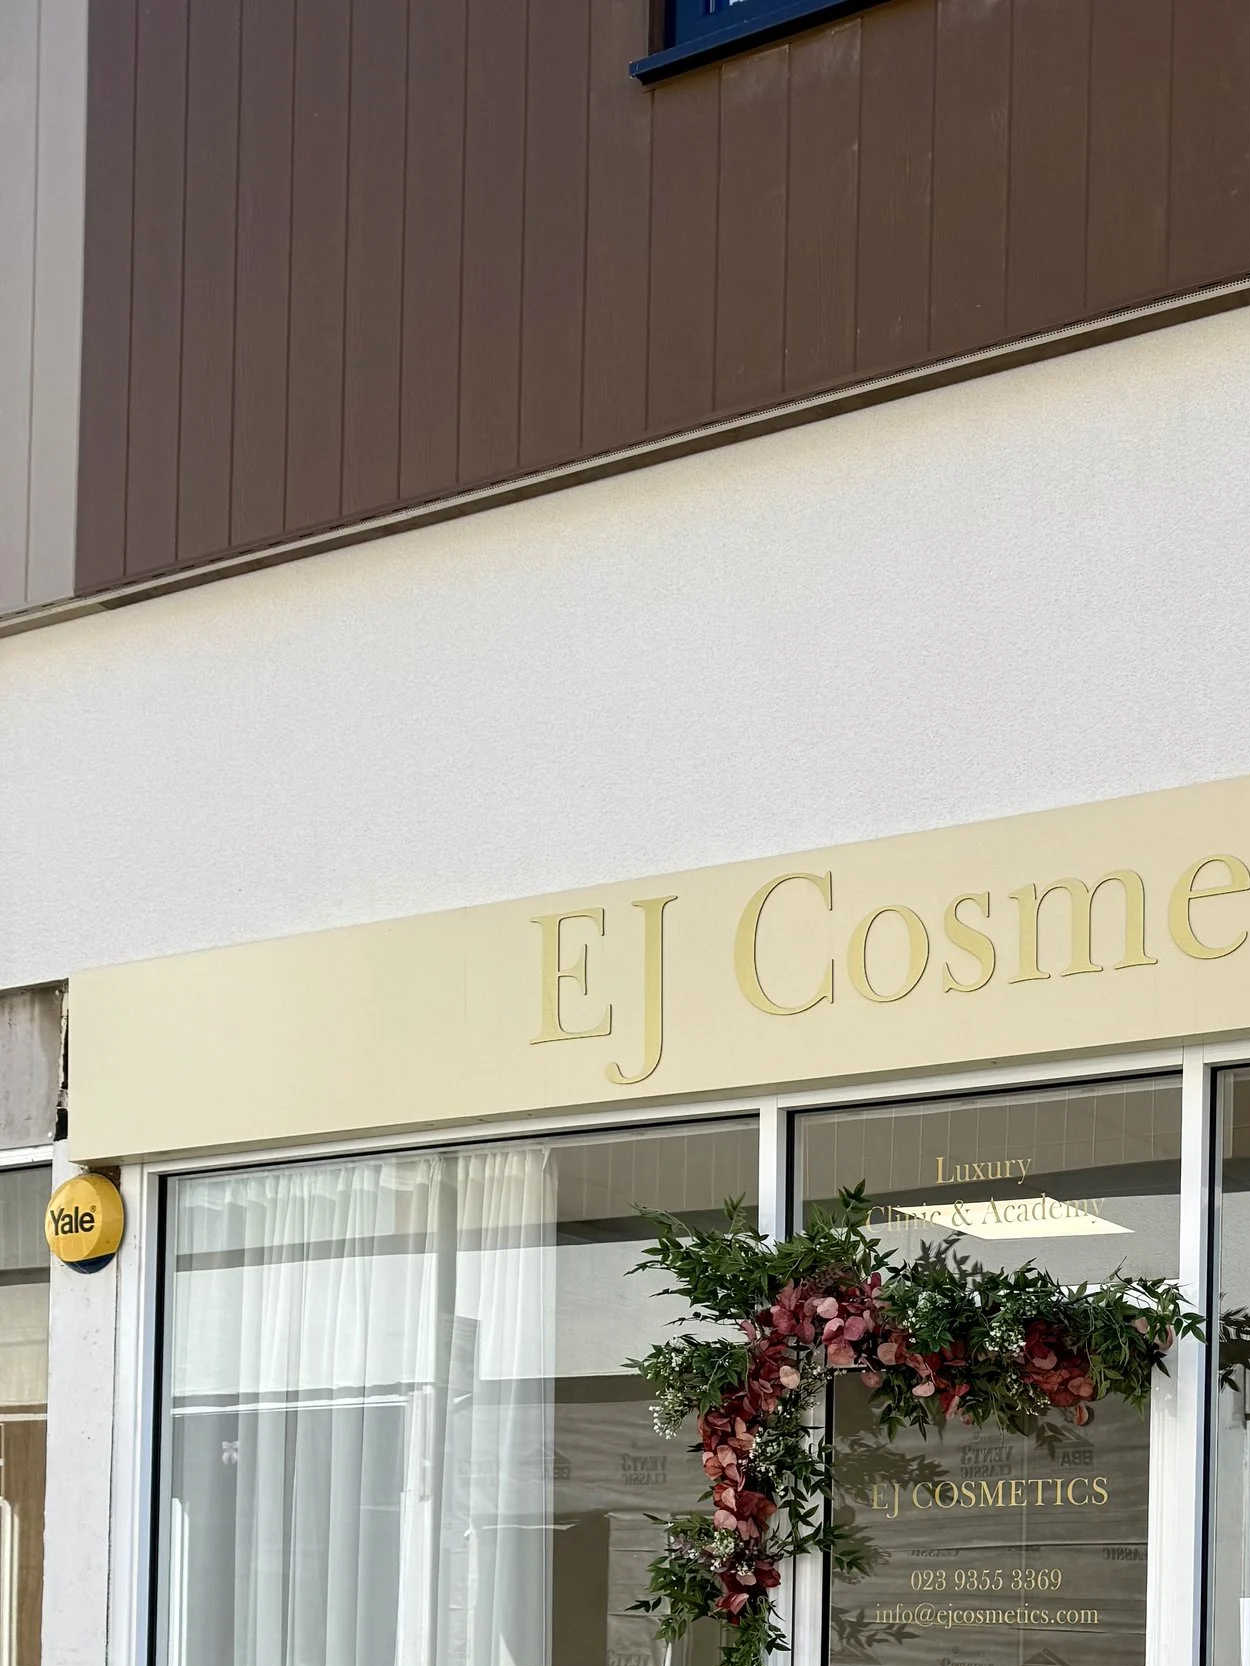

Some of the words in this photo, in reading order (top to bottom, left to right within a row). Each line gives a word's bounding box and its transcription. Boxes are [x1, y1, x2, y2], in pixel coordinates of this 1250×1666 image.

[530, 895, 678, 1085] EJ
[935, 1156, 1032, 1185] Luxury
[50, 1205, 95, 1236] Yale
[865, 1201, 943, 1234] Clinic
[951, 1199, 973, 1228] &
[980, 1193, 1105, 1225] Academy
[871, 1481, 901, 1519] EJ
[912, 1476, 1109, 1511] COSMETICS
[910, 1569, 947, 1591] 023
[954, 1568, 1003, 1591] 9355
[1011, 1568, 1062, 1590] 3369
[875, 1602, 1099, 1629] info@ejcosmetics.com
